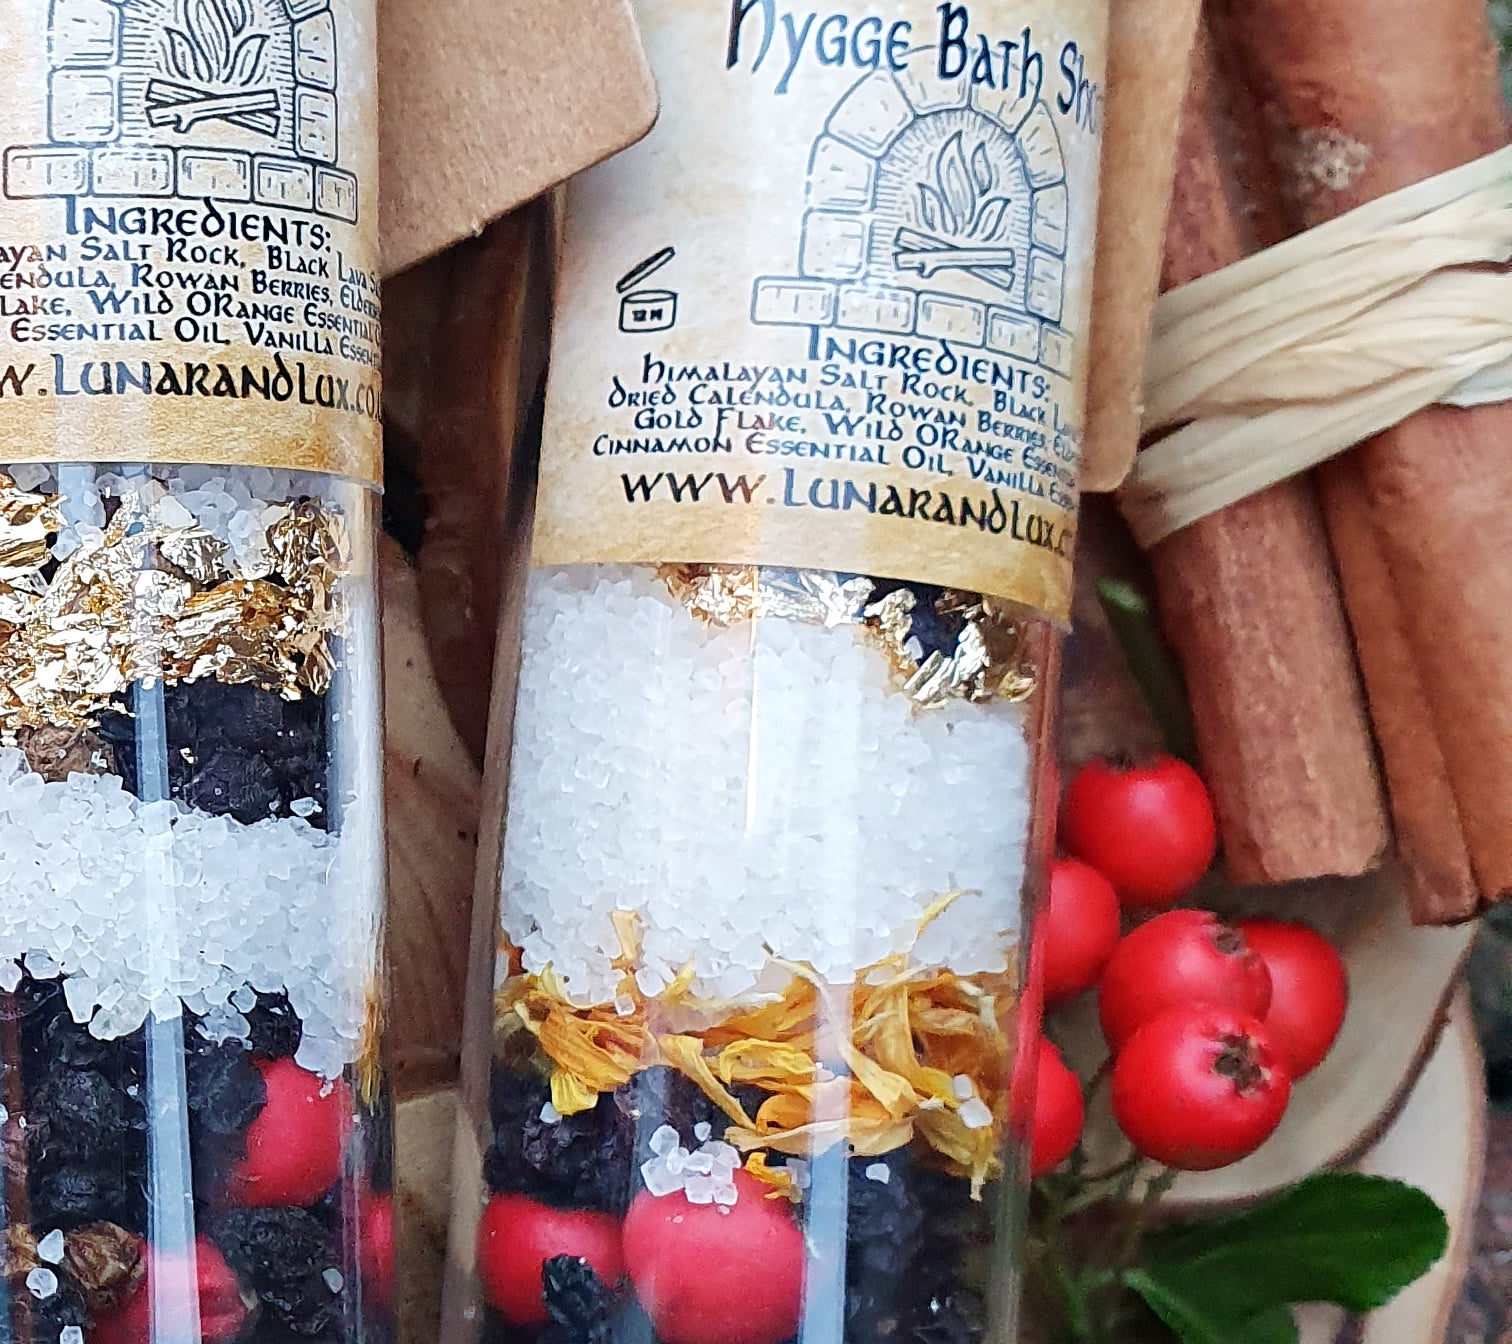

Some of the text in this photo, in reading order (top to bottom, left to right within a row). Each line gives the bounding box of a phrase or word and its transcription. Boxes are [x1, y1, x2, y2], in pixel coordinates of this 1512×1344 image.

[937, 1, 1044, 100] Bath
[65, 196, 331, 252] Ingredients:
[80, 236, 152, 261] Salt
[267, 245, 329, 279] Black
[337, 251, 367, 290] Lava
[132, 263, 239, 292] Rowan
[251, 269, 333, 307] Berries,
[10, 318, 162, 343] Essential
[243, 321, 333, 355] Vanilla
[86, 290, 174, 315] Wild
[304, 303, 373, 344] Essential
[642, 352, 807, 393] Himalayan
[819, 363, 888, 391] Salt
[994, 390, 1045, 425] Black
[808, 325, 1051, 402] Ingredients:
[634, 407, 702, 430] Gold
[823, 412, 903, 441] Wild
[867, 392, 966, 427] Rowan
[593, 434, 732, 456] Cinnamon
[745, 432, 891, 465] Essential
[967, 456, 1044, 497] Vanilla
